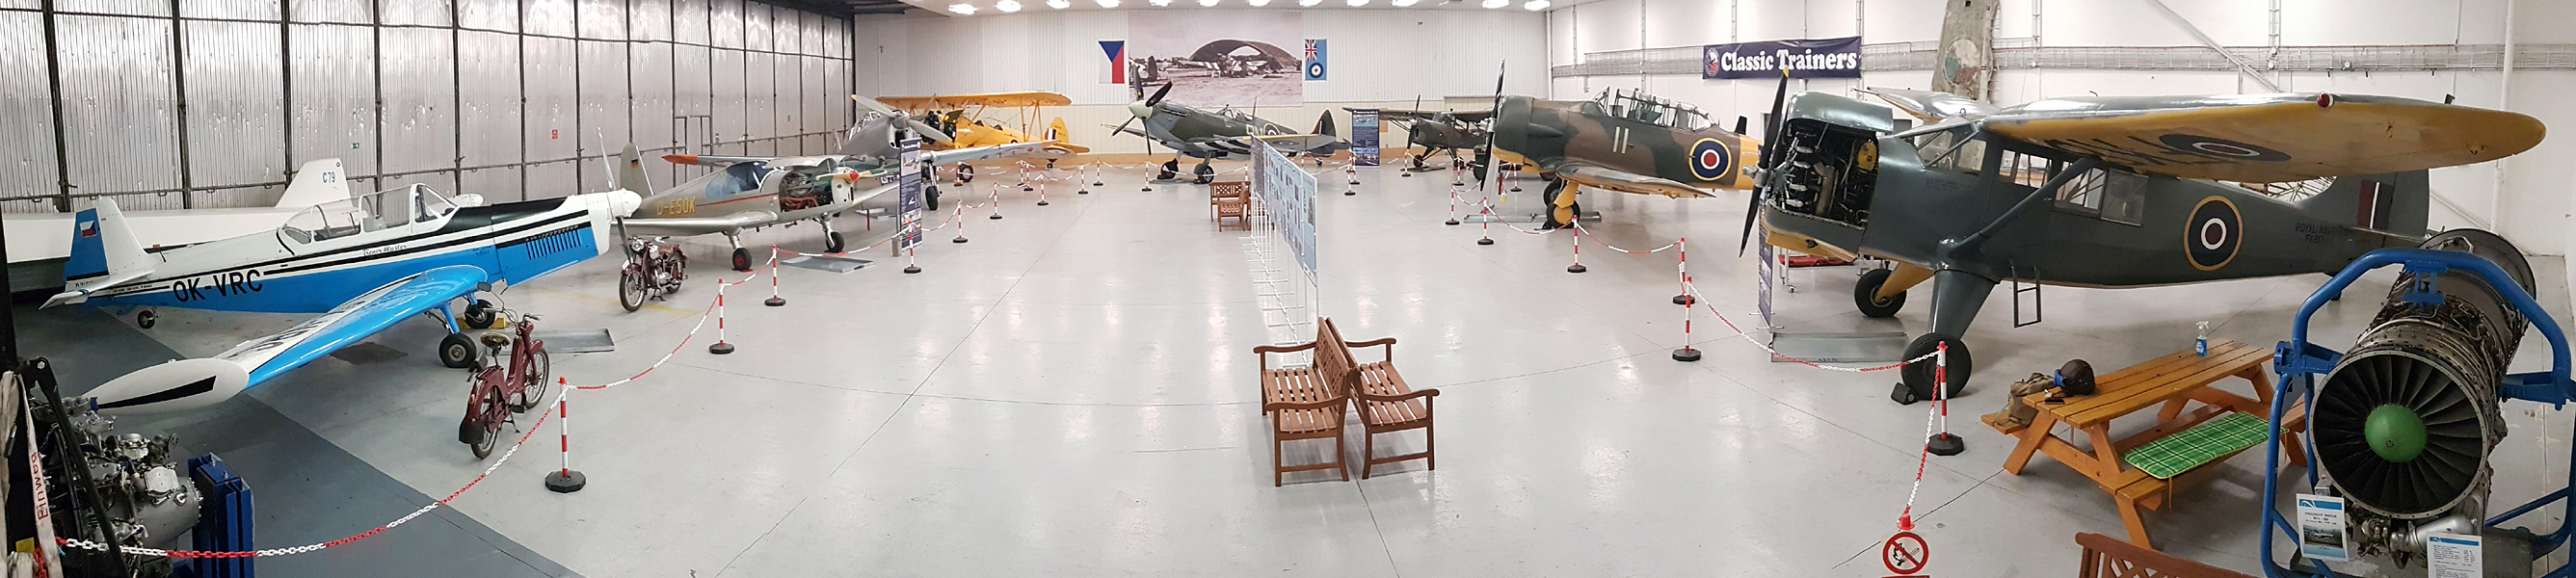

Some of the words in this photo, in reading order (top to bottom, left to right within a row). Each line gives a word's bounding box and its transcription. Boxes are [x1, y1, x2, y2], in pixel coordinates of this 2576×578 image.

[1720, 50, 1774, 71] Classic
[1776, 48, 1857, 70] Trainers
[1612, 126, 1630, 154] 11
[322, 171, 335, 183] C79
[656, 196, 697, 216] D-ESOK
[2296, 223, 2316, 233] ROYAL
[173, 269, 263, 302] OK-VRC
